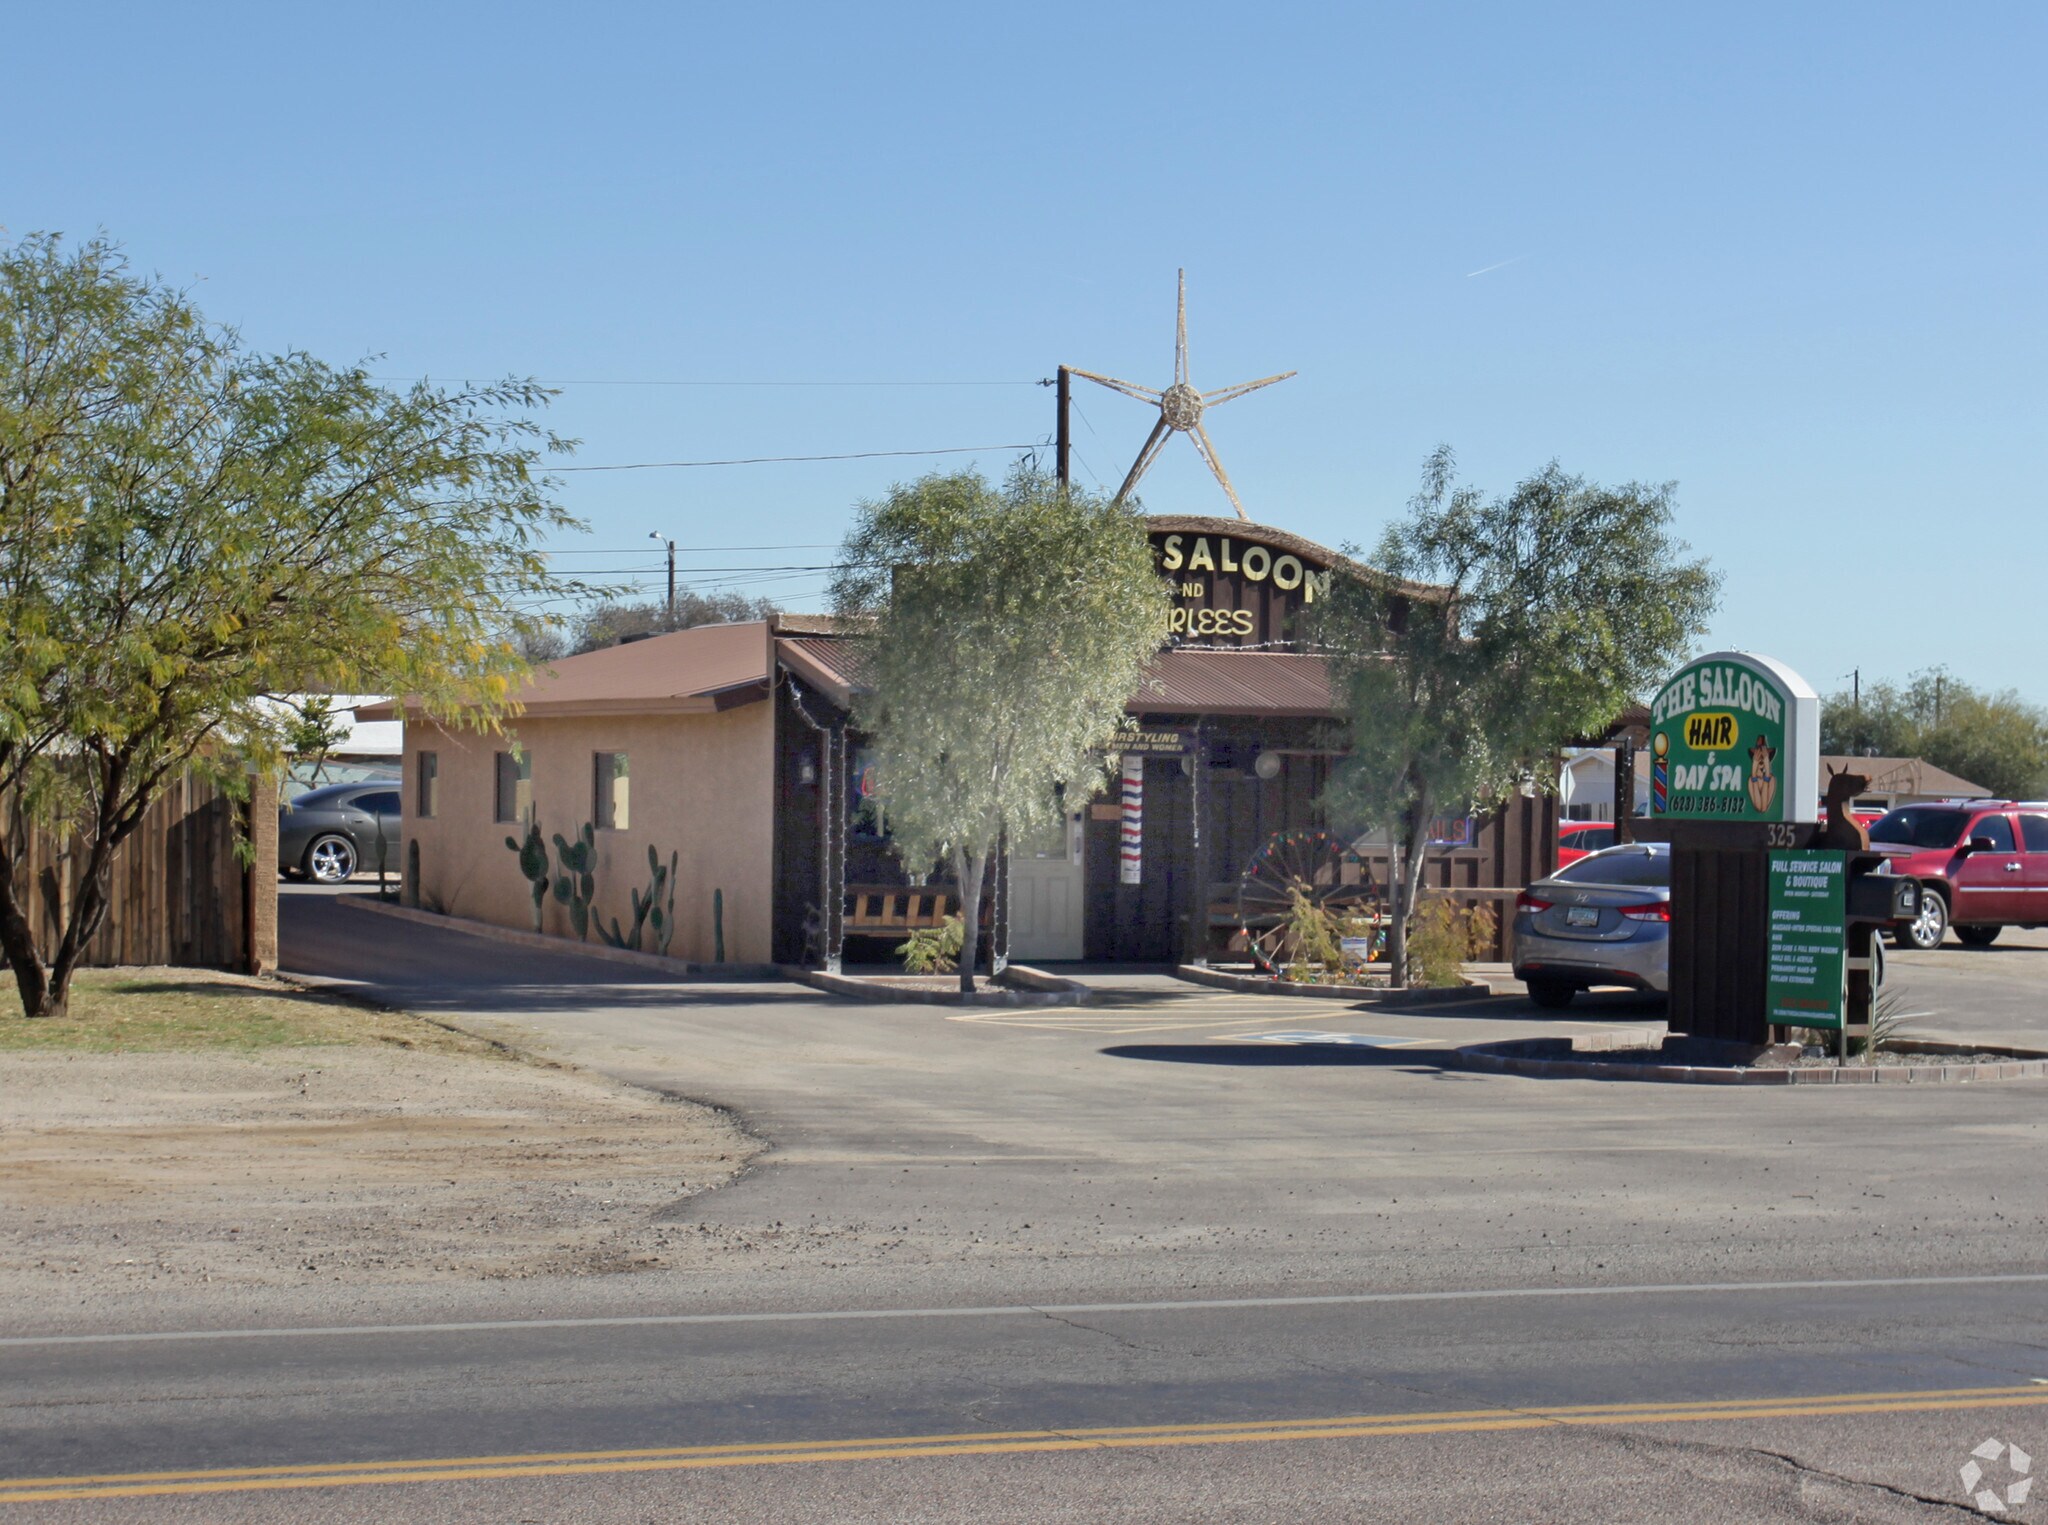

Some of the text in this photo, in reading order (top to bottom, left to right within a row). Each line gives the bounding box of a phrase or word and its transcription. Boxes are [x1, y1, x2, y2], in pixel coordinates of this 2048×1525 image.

[1163, 535, 1331, 603] SALOON
[1180, 583, 1204, 597] ND
[1653, 668, 1781, 725] THE SALOON
[1689, 716, 1732, 746] HAIR
[1674, 765, 1742, 791] DAY SPA
[1669, 795, 1745, 813] (623) 386-8132
[1768, 824, 1796, 848] 325
[1771, 860, 1842, 874] FULL SERVICE SALON
[1792, 875, 1828, 888] BOUTIQUE
